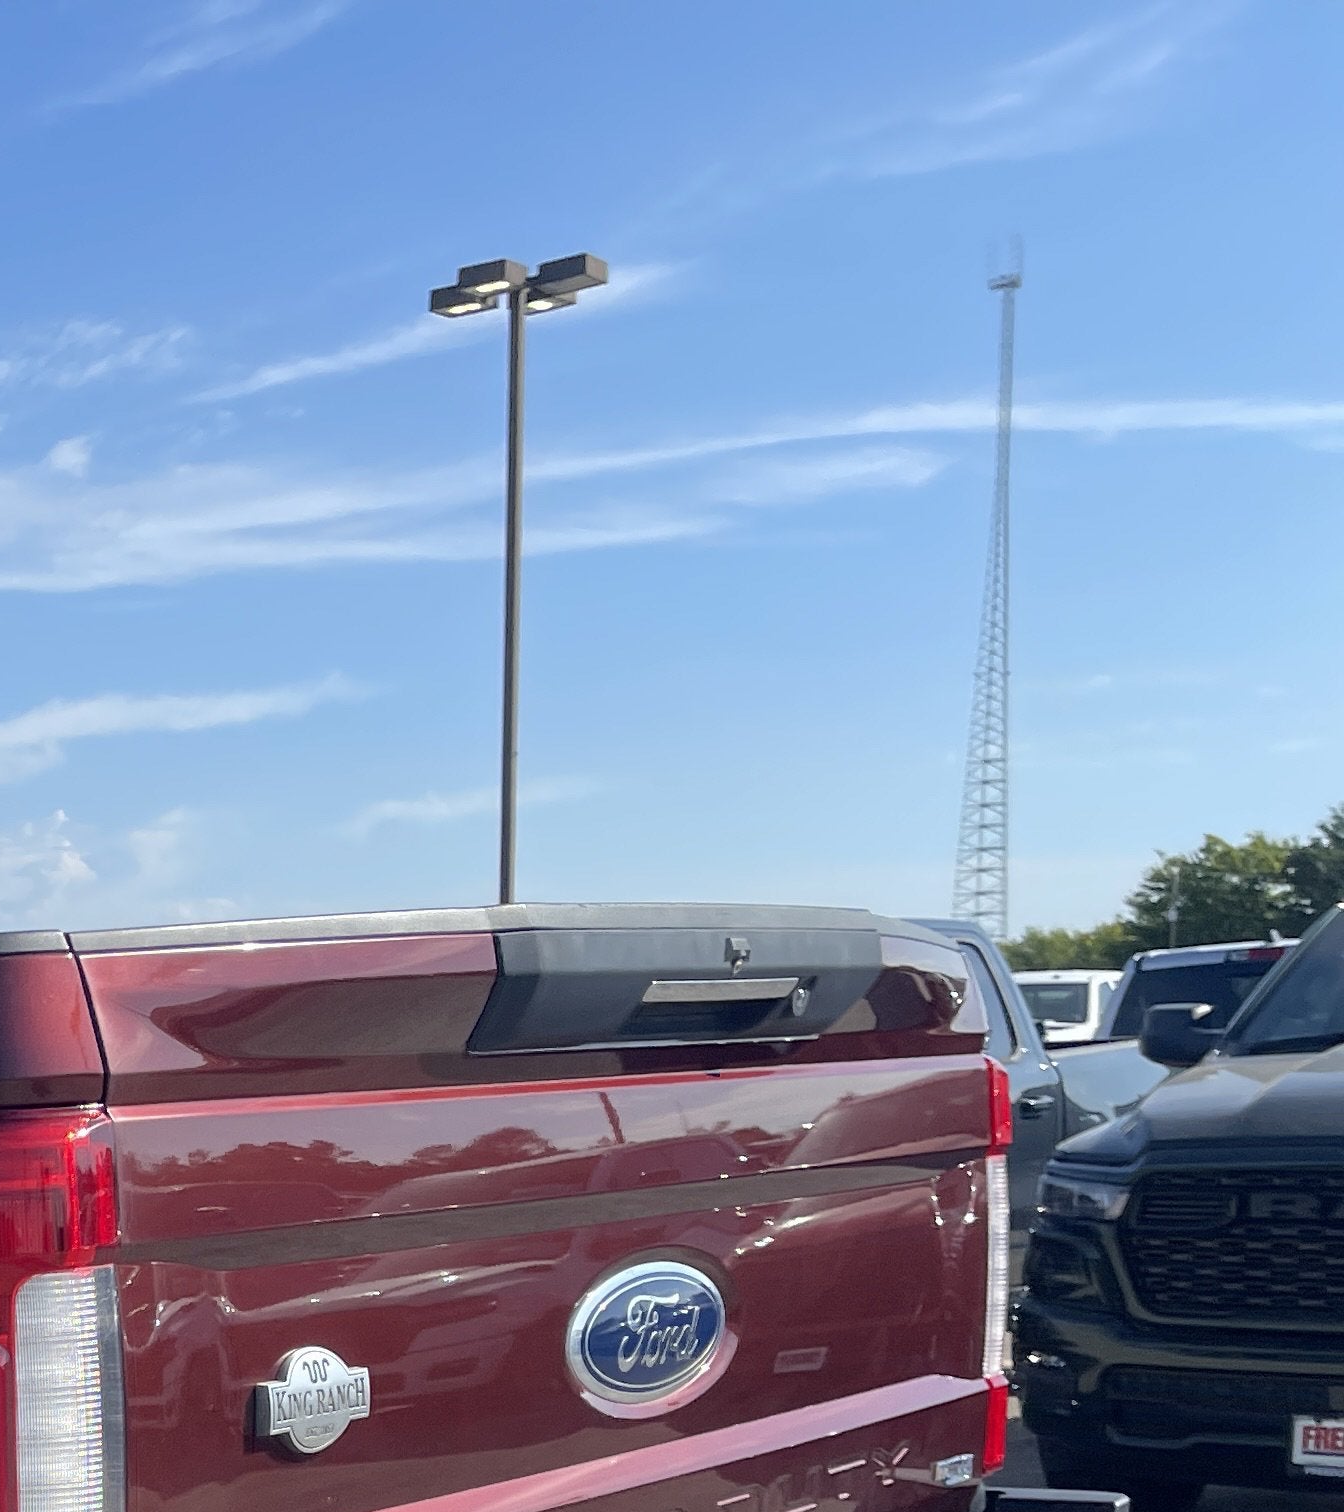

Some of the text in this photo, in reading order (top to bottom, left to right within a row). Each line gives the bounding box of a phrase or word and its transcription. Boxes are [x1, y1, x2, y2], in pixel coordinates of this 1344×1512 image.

[617, 1293, 701, 1372] Ford
[275, 1377, 366, 1421] KING RANCH
